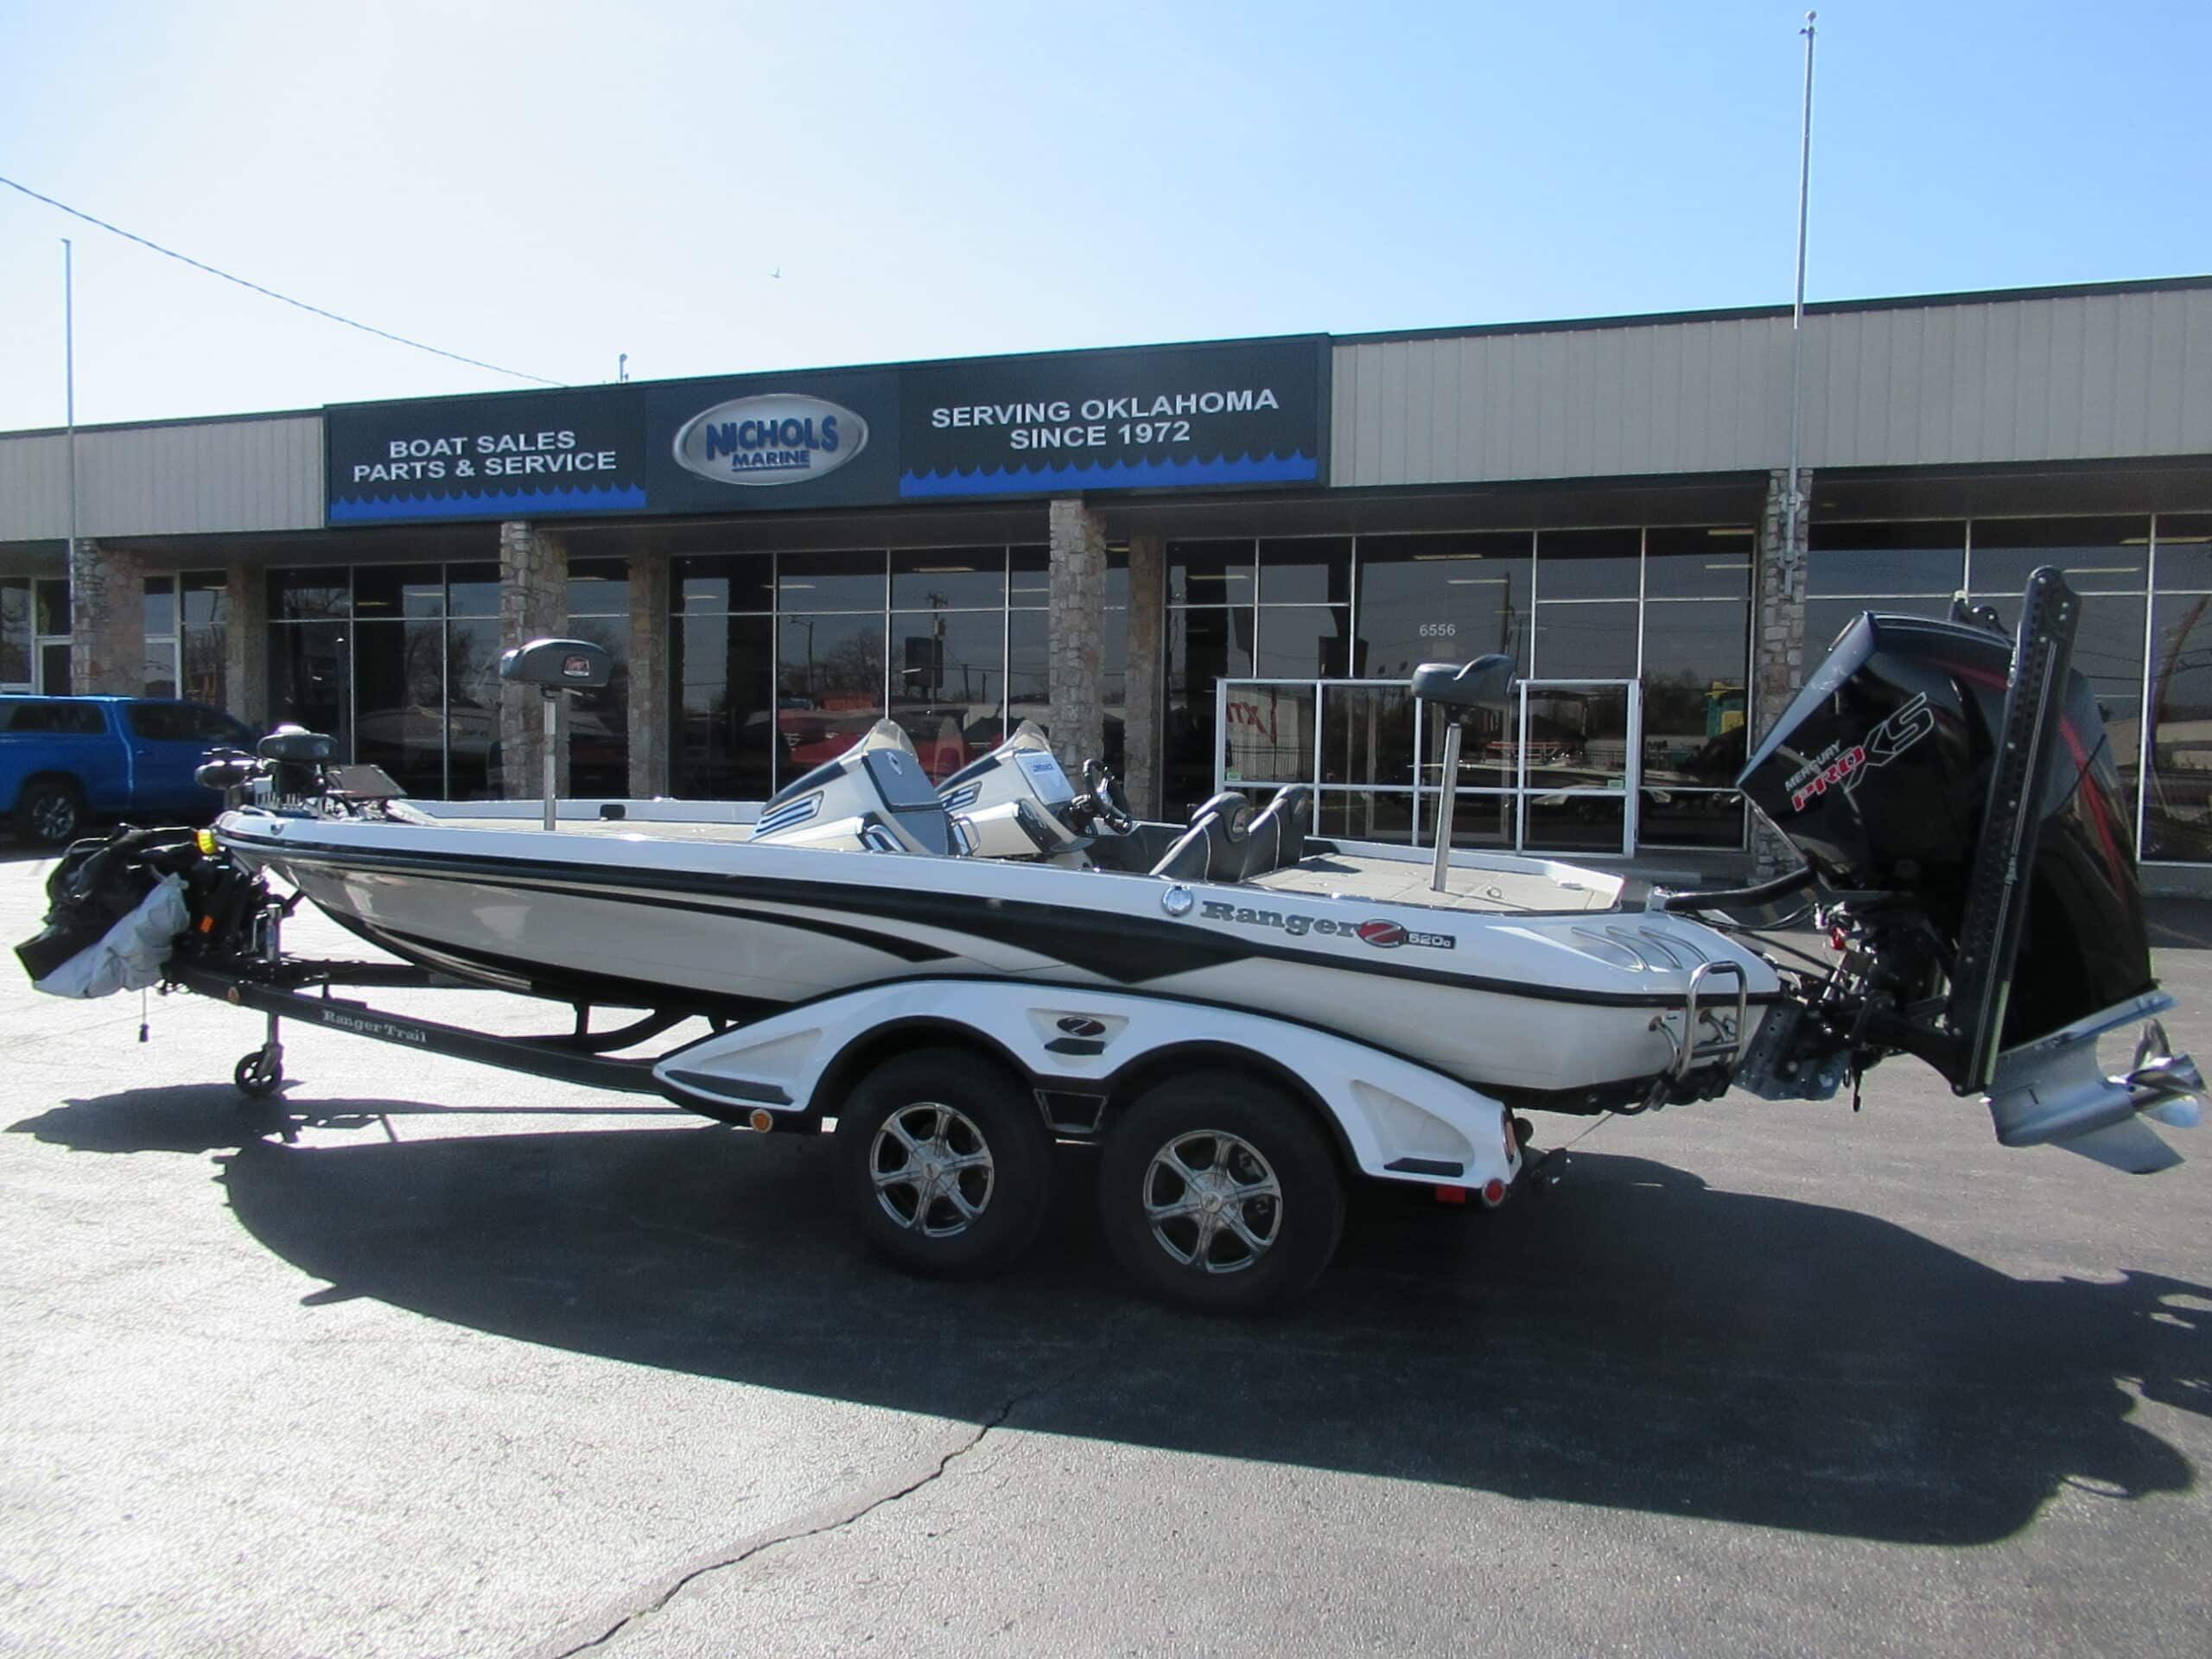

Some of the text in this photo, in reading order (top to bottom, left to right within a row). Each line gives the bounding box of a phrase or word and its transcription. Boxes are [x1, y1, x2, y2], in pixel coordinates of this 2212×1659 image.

[931, 388, 1280, 428] SERVING OKLAHOMA
[389, 430, 576, 459] BOAT SALES
[706, 415, 839, 461] NICHOLS
[1009, 421, 1190, 450] SINCE 1972
[353, 451, 617, 483] PARTS & SERVICE
[732, 449, 810, 467] MARINE
[1419, 623, 1456, 637] 6556
[1784, 740, 1840, 791] MERCURY
[1791, 691, 1935, 812] PRO XS
[1200, 899, 1358, 937] Ranger
